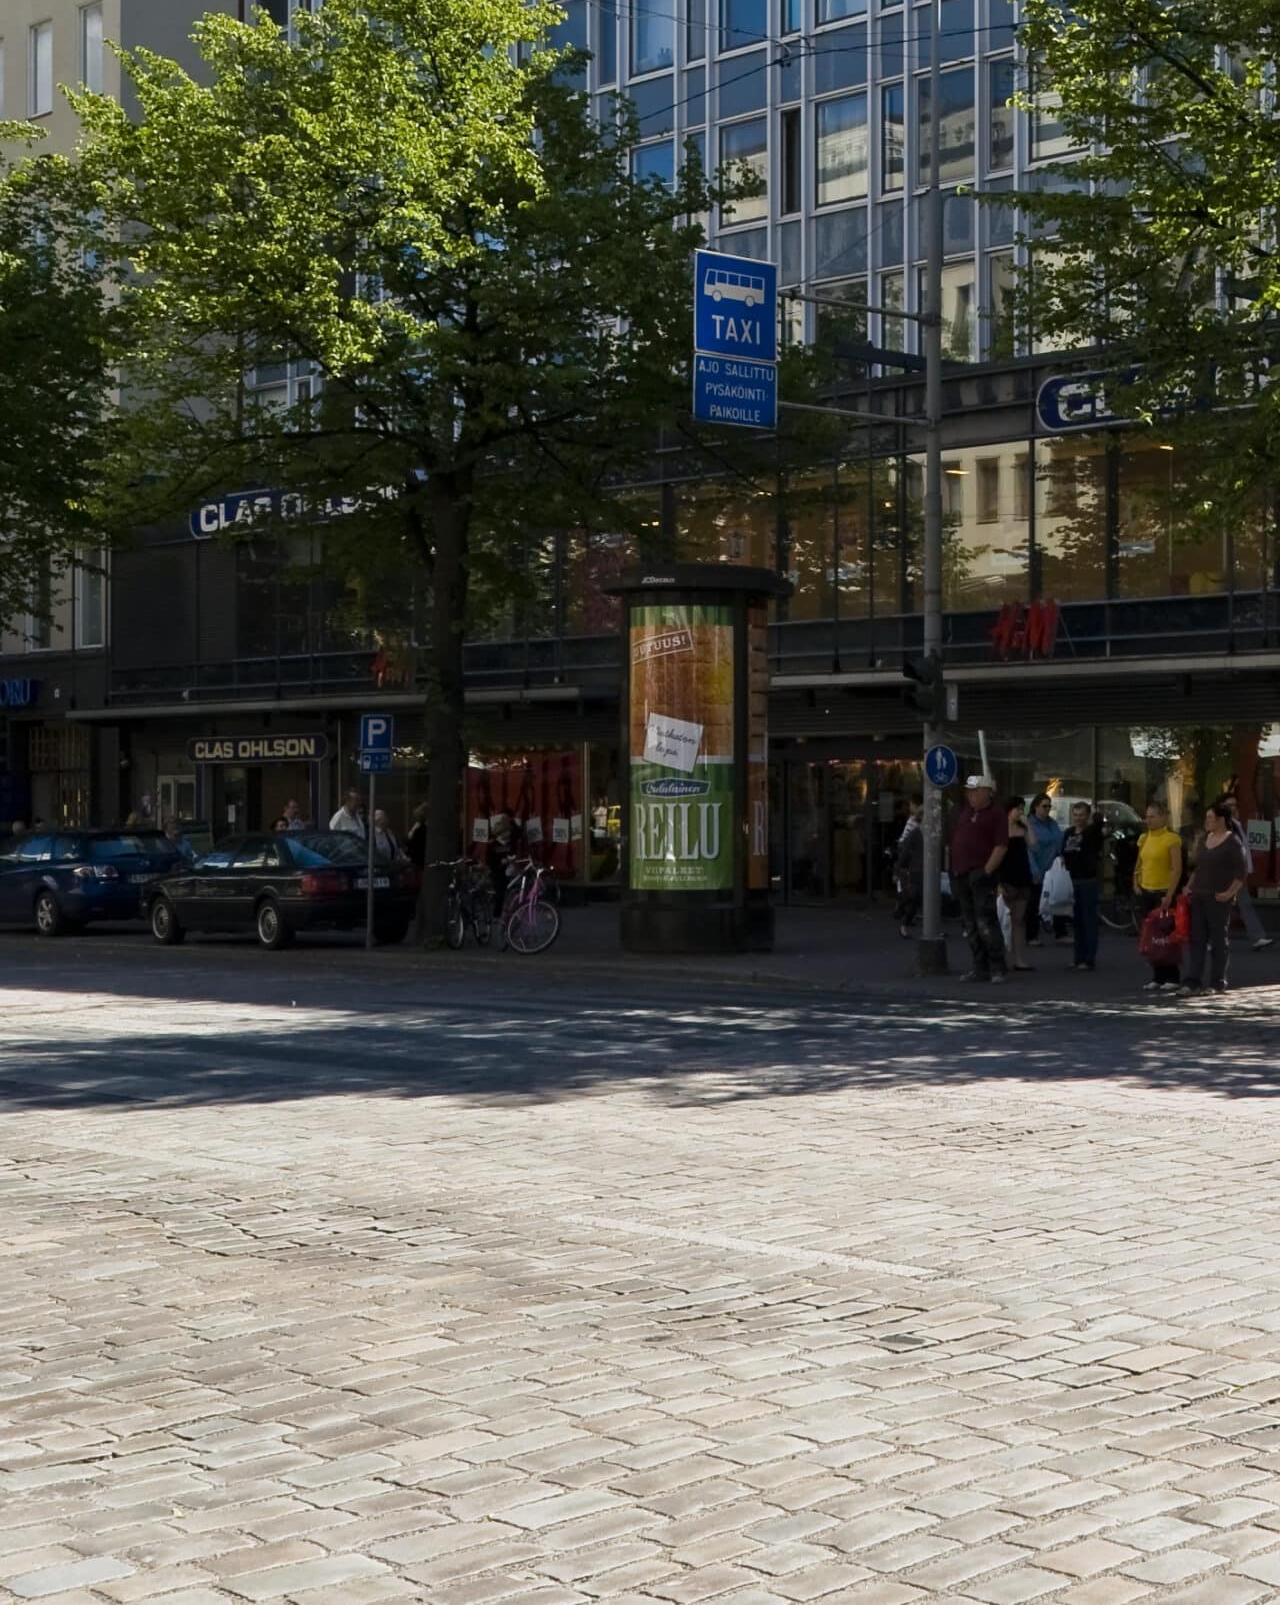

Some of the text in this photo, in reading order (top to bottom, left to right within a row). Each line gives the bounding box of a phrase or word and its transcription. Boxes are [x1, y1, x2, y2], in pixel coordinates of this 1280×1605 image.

[711, 314, 761, 345] TAXI
[699, 359, 774, 382] AJO SALLITTU
[710, 404, 761, 424] PAIKOILLE
[368, 718, 387, 747] P
[195, 738, 316, 759] CLAS OHLSON
[634, 802, 722, 861] REILU
[1249, 832, 1268, 845] 50%
